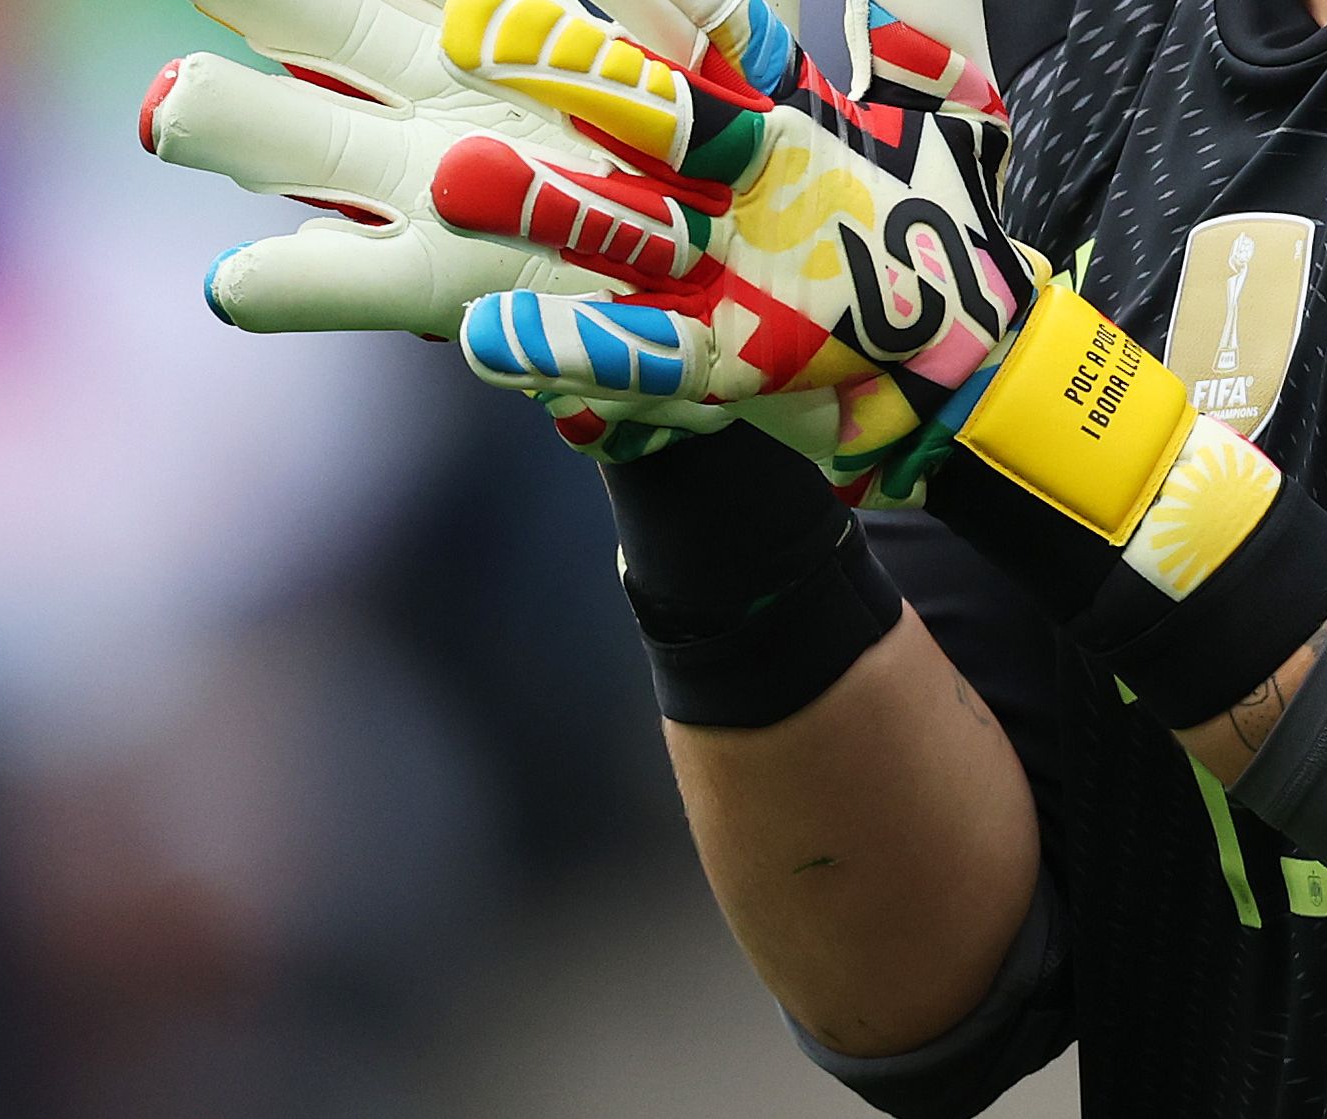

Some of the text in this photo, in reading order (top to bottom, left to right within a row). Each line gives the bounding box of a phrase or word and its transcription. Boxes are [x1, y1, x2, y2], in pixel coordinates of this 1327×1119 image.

[1063, 323, 1117, 406] POC A POC
[1088, 374, 1130, 428] BONA
[1192, 376, 1248, 410] FIFA
[1080, 425, 1101, 440] I
